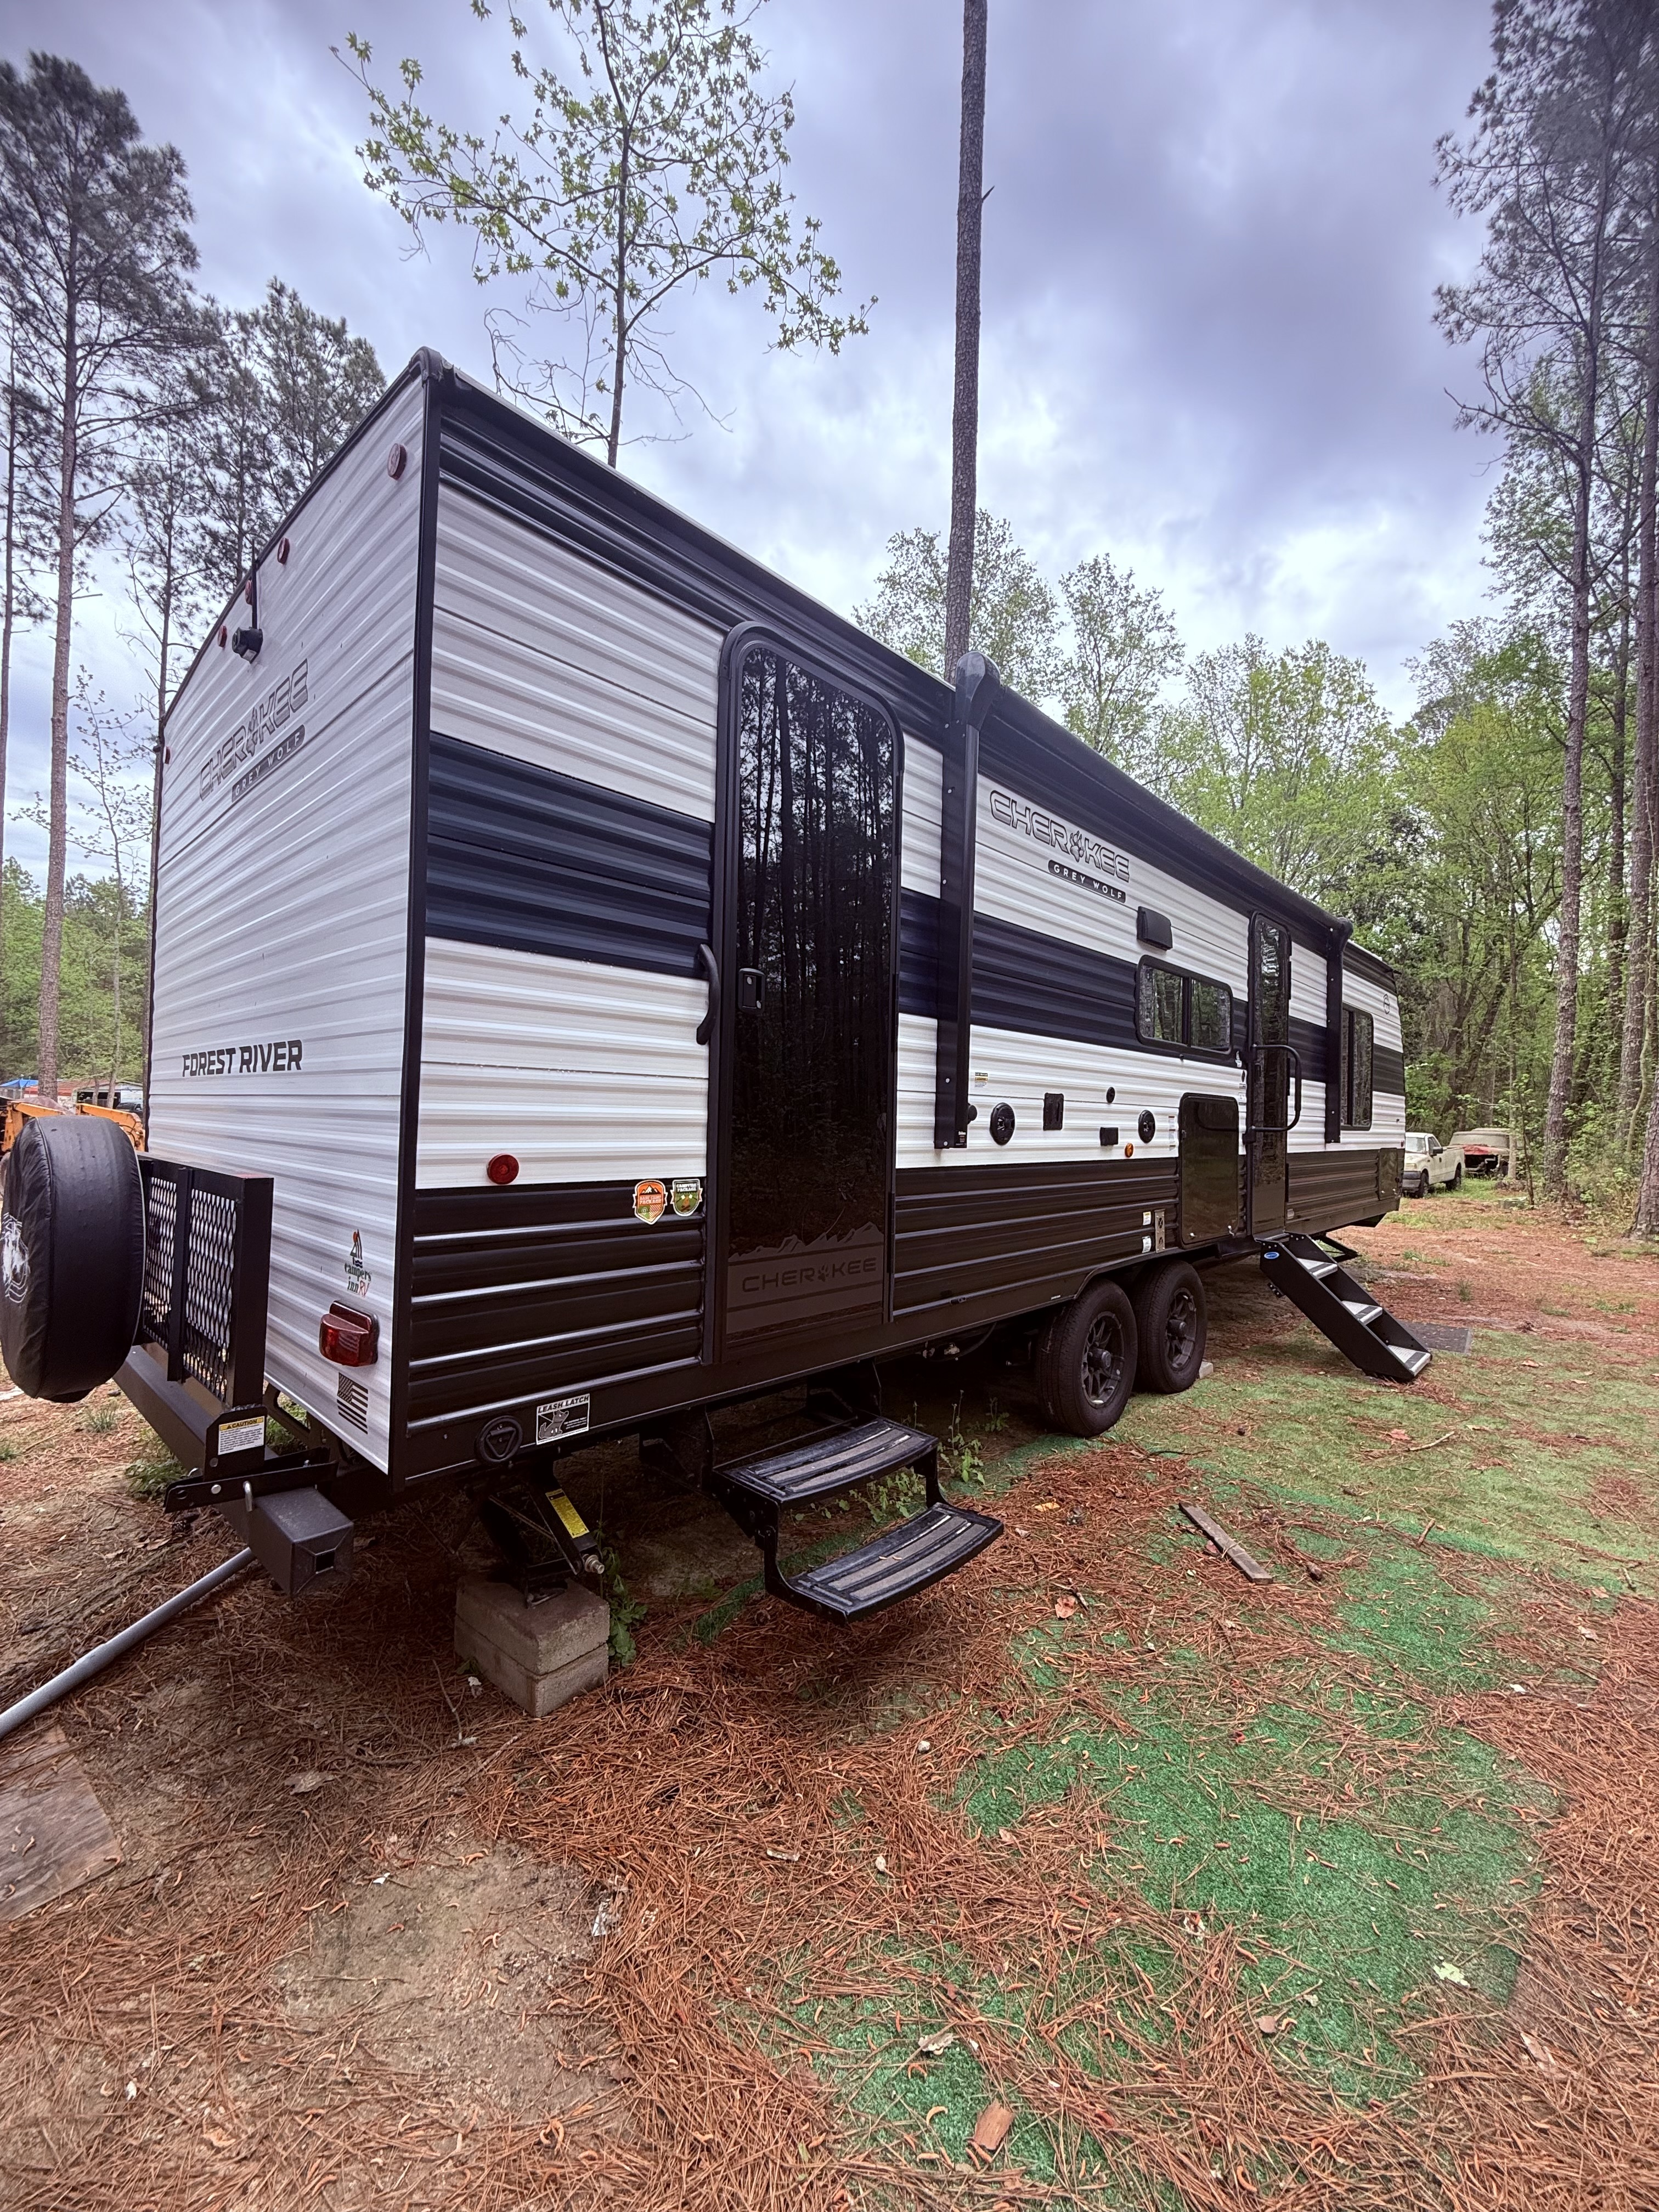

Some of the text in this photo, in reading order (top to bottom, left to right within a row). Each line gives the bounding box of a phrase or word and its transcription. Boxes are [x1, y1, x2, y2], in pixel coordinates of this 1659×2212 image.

[235, 731, 301, 795] GREY WOLF
[1053, 864, 1122, 899] GREY WOLF
[182, 1040, 302, 1077] FOREST RIVER
[538, 1395, 589, 1414] LEASH LATCH
[232, 1419, 257, 1428] CAUTION
